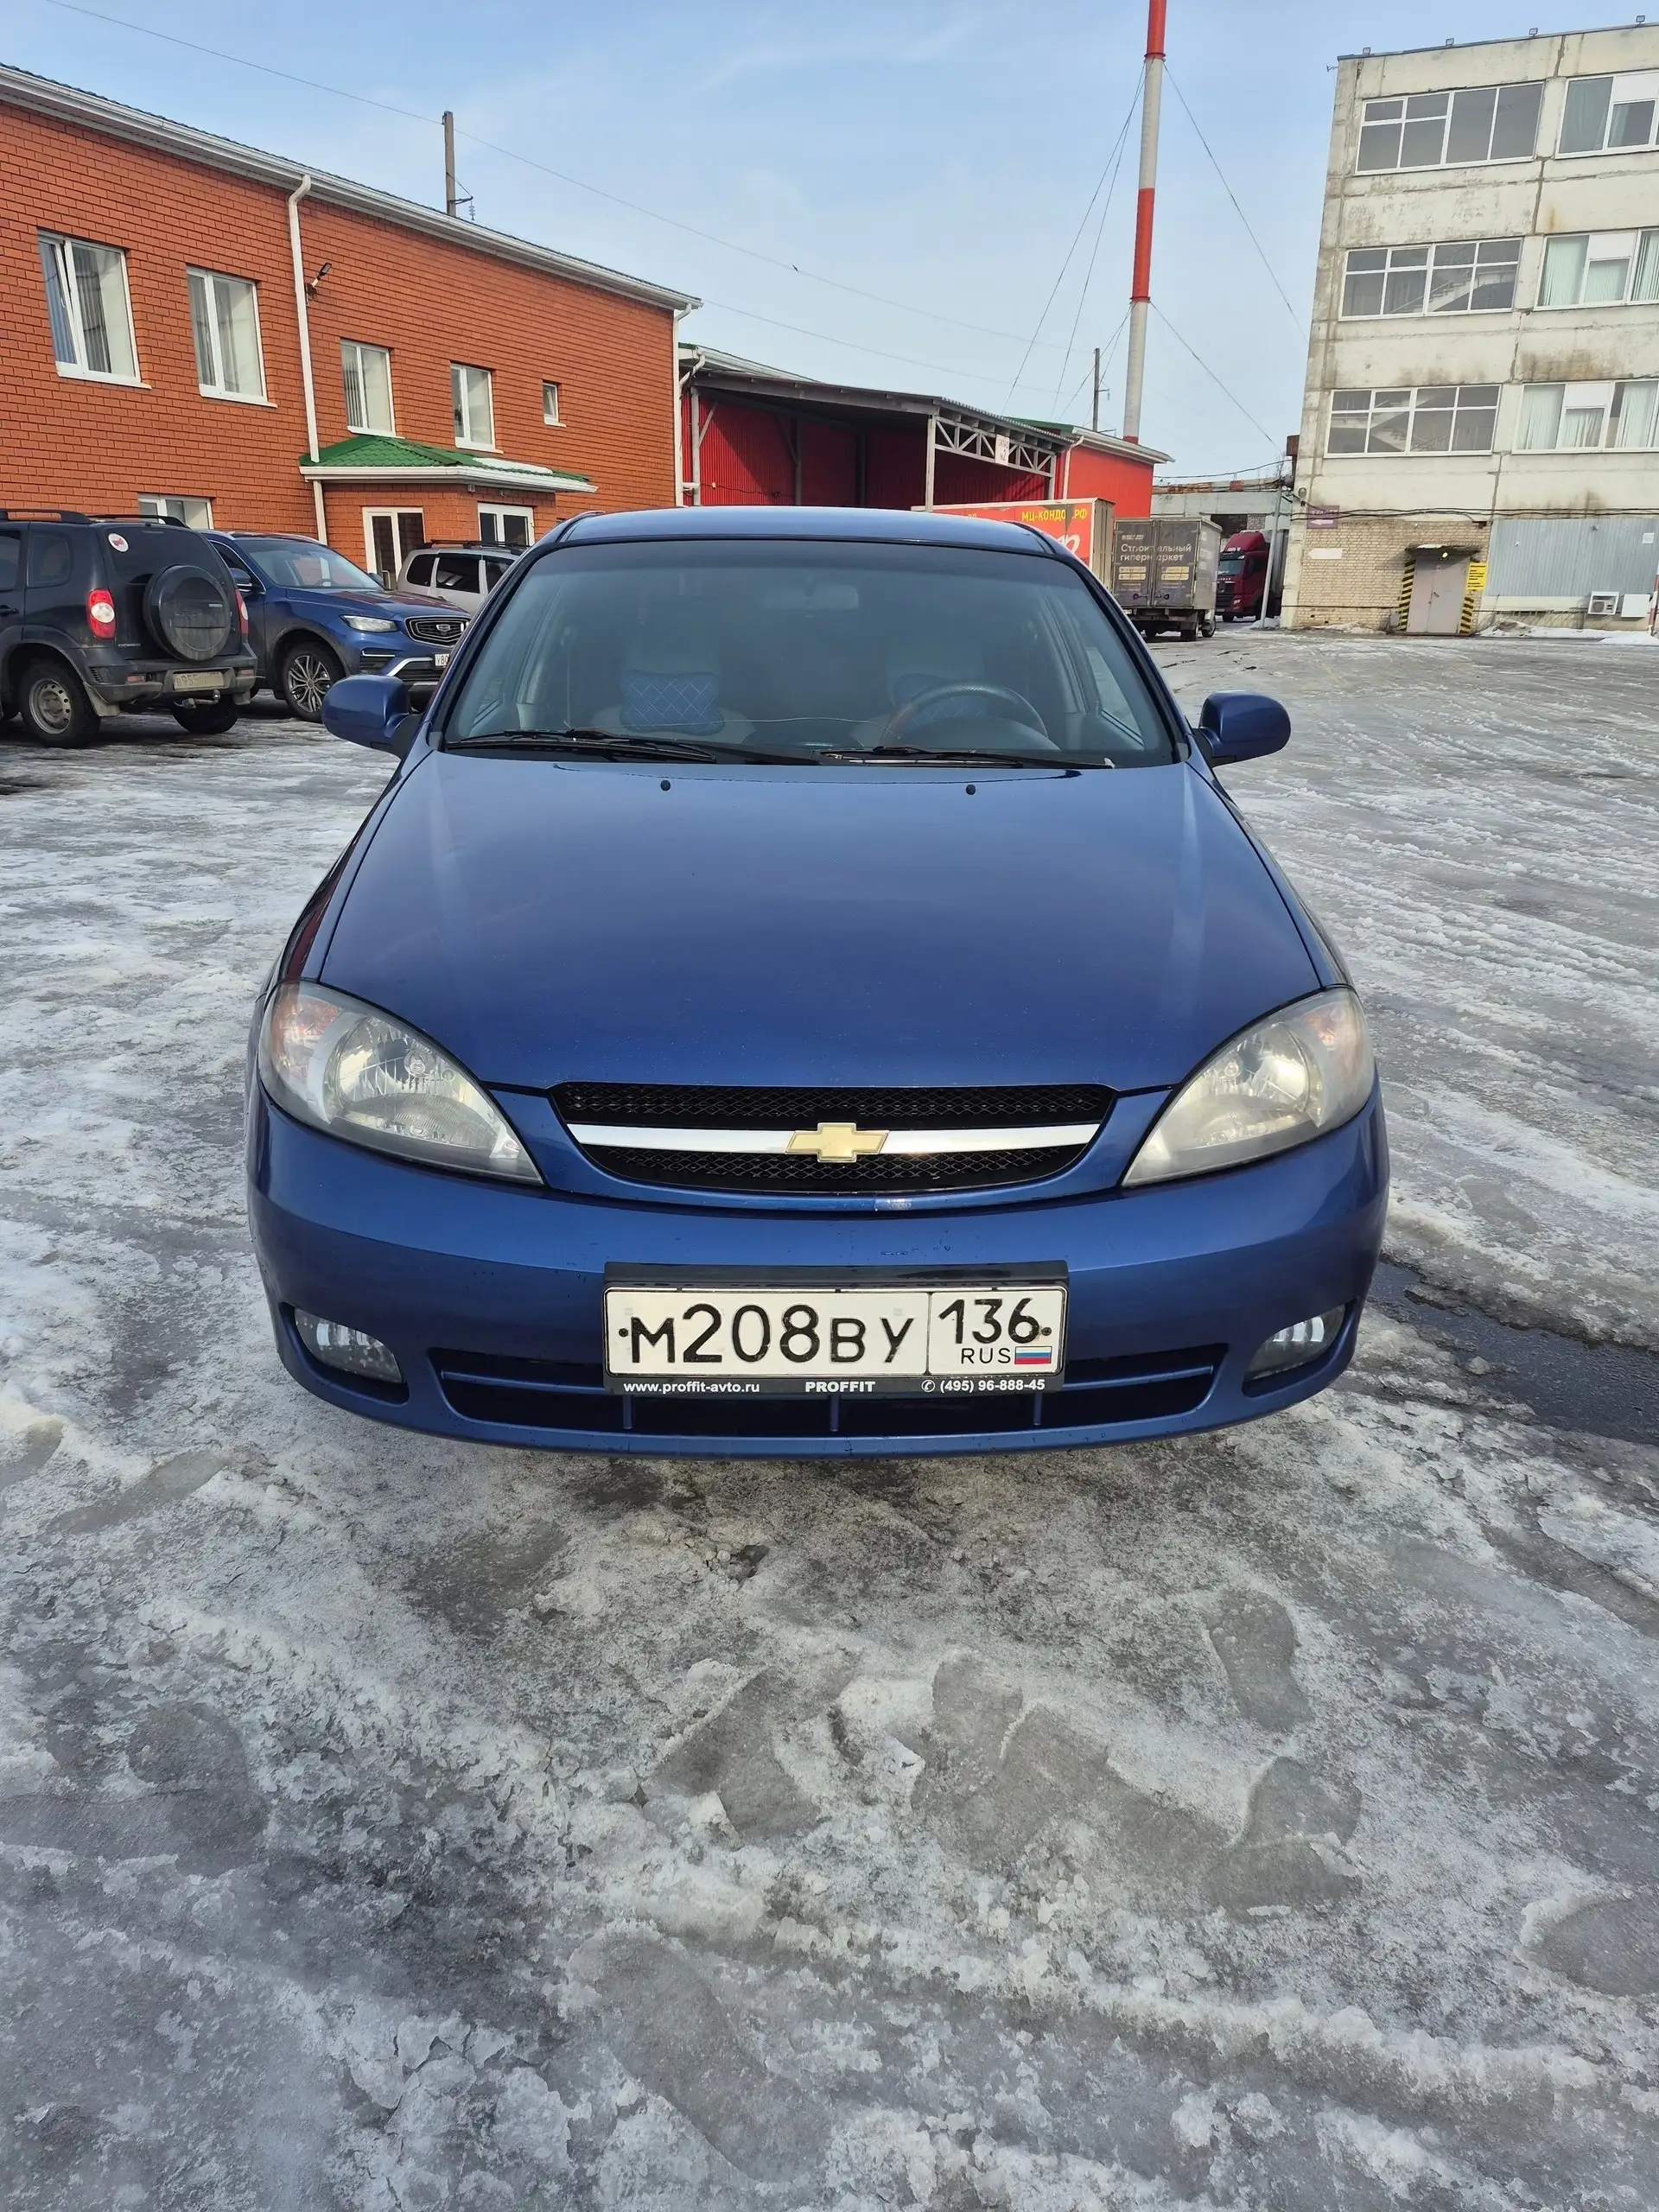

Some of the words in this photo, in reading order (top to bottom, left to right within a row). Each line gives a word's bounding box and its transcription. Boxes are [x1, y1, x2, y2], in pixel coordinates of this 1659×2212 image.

[1021, 508, 1088, 522] МЦ-КОНДО.РФ
[631, 1303, 915, 1363] М208ВУ
[938, 1297, 1040, 1344] 136
[961, 1347, 1011, 1364] RUS
[623, 1381, 760, 1394] www.proffit-avto.ru
[804, 1381, 875, 1392] PROFFIT
[939, 1380, 975, 1393] (495)
[977, 1378, 1046, 1392] 96-888-45
